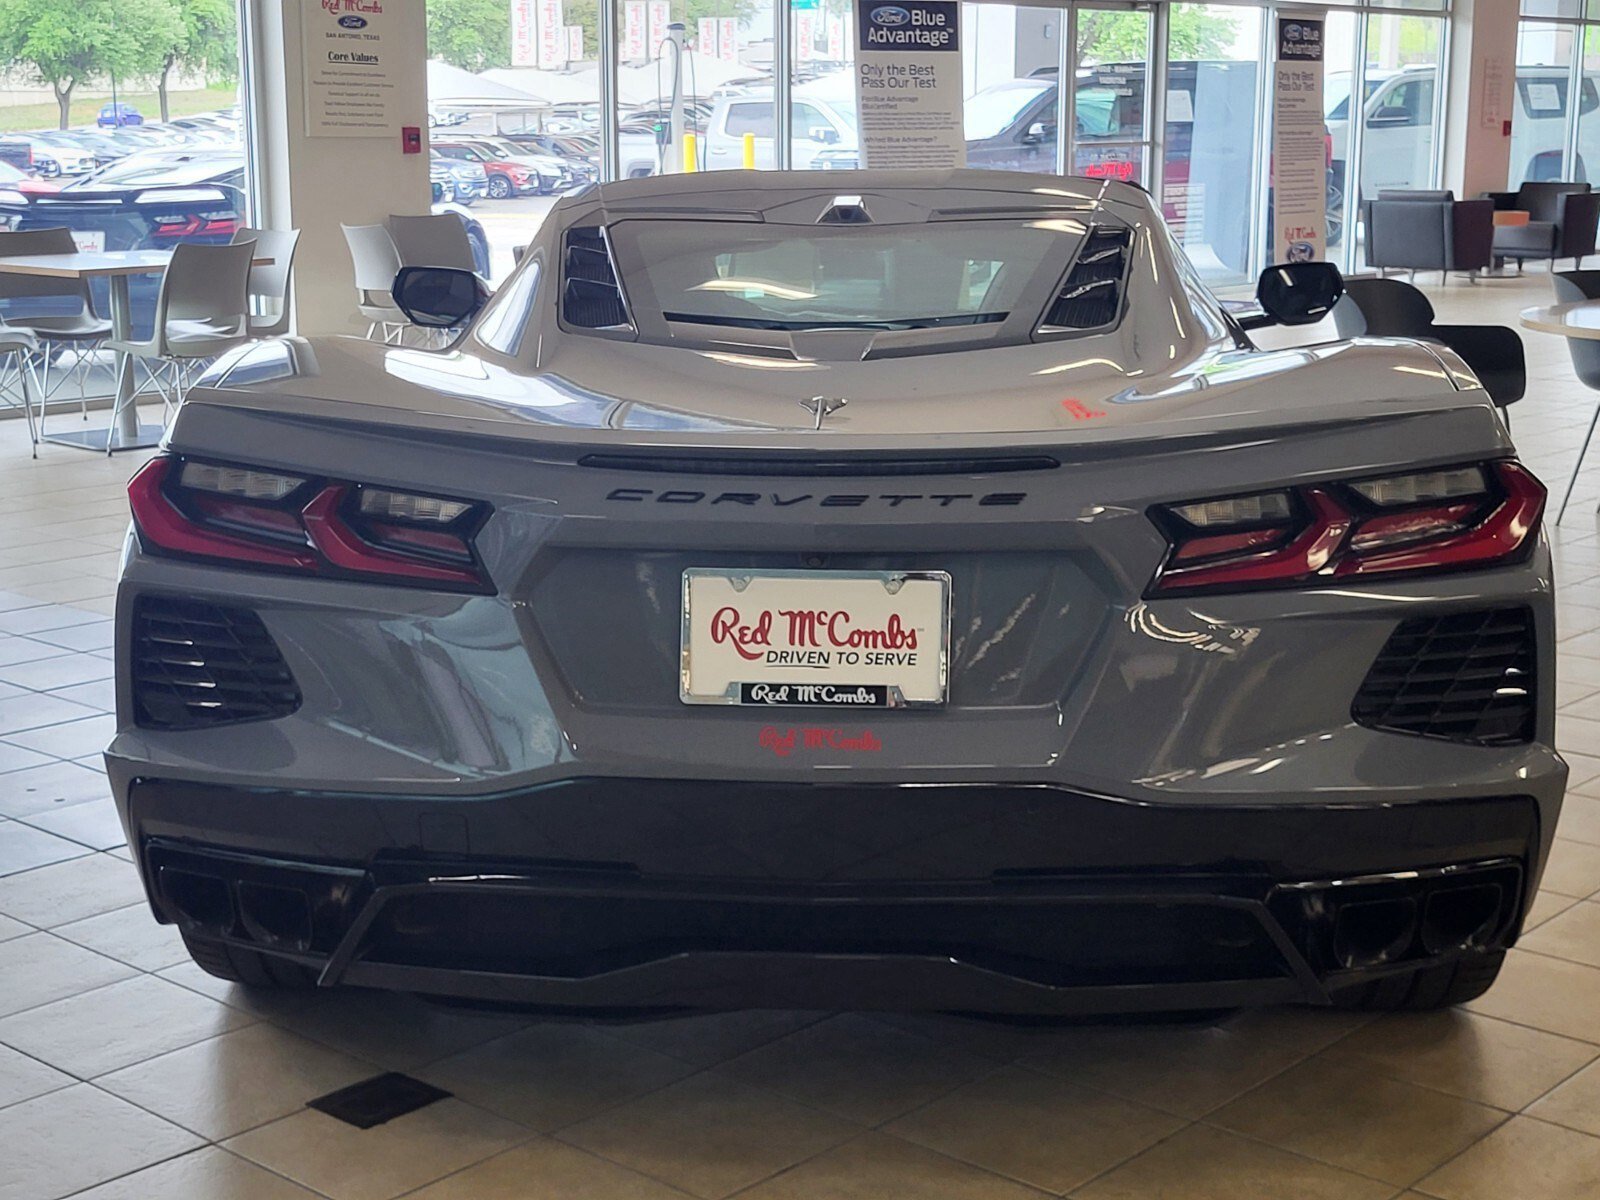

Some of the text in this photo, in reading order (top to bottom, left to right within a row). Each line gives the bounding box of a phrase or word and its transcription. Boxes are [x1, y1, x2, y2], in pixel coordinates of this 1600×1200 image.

[321, 0, 383, 15] Red McCombs
[874, 8, 946, 26] Ford Blue
[868, 27, 950, 47] Advantage
[1302, 26, 1320, 41] Blue
[328, 50, 379, 63] Core Values
[860, 63, 935, 77] Only the Best
[861, 77, 937, 89] Pass Our Test
[605, 488, 1028, 507] CORVETTE
[710, 606, 918, 660] Red McCombs
[766, 650, 918, 666] DRIVEN TO SERVE
[751, 683, 877, 704] Red McCombs
[759, 725, 883, 756] Red McCombs
